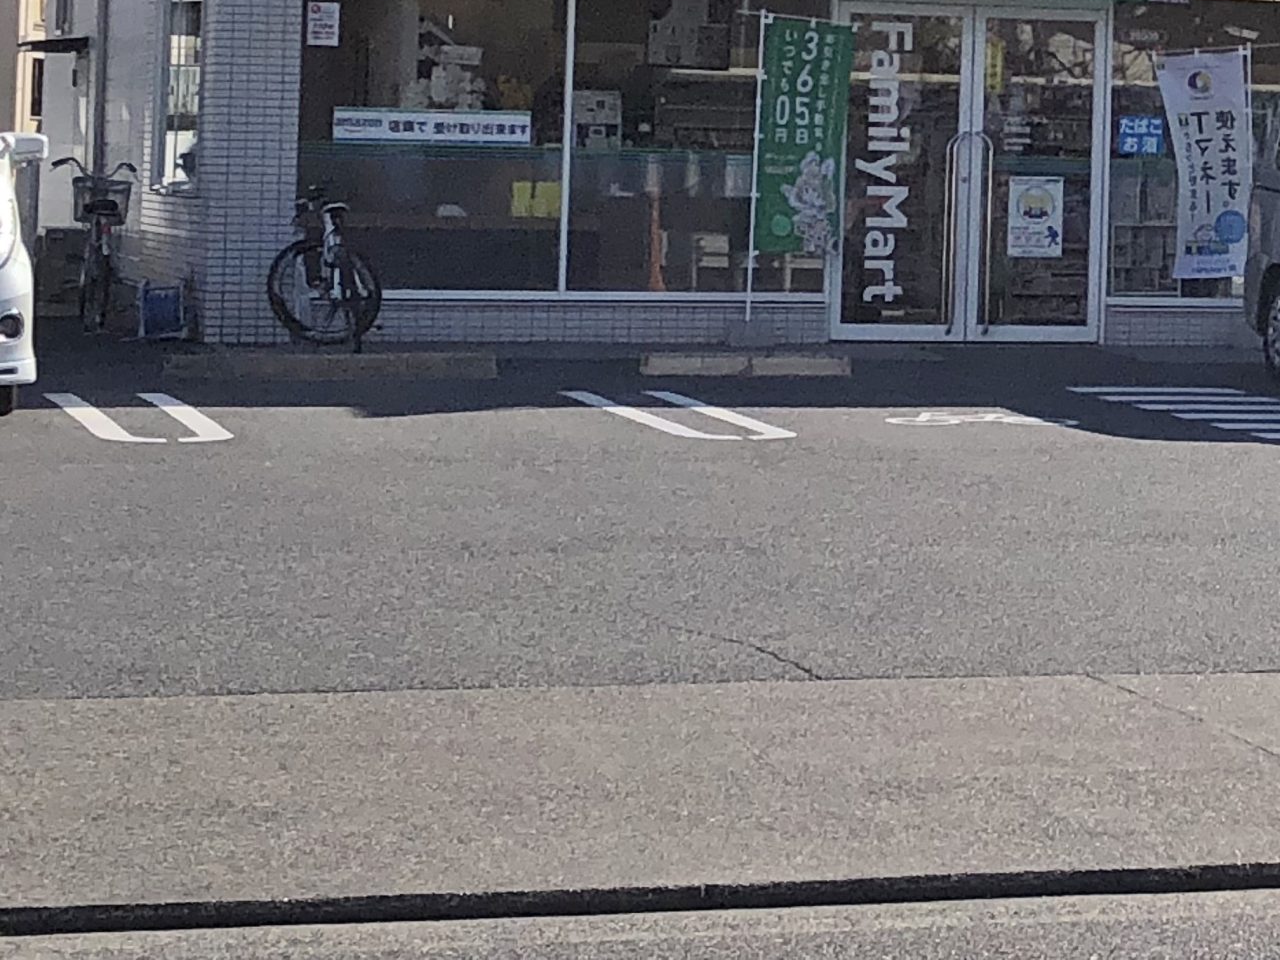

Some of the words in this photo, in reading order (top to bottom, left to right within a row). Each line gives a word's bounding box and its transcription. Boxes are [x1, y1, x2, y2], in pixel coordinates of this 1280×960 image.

[855, 21, 914, 303] FamilyMart
[1120, 118, 1162, 135] たばこ
